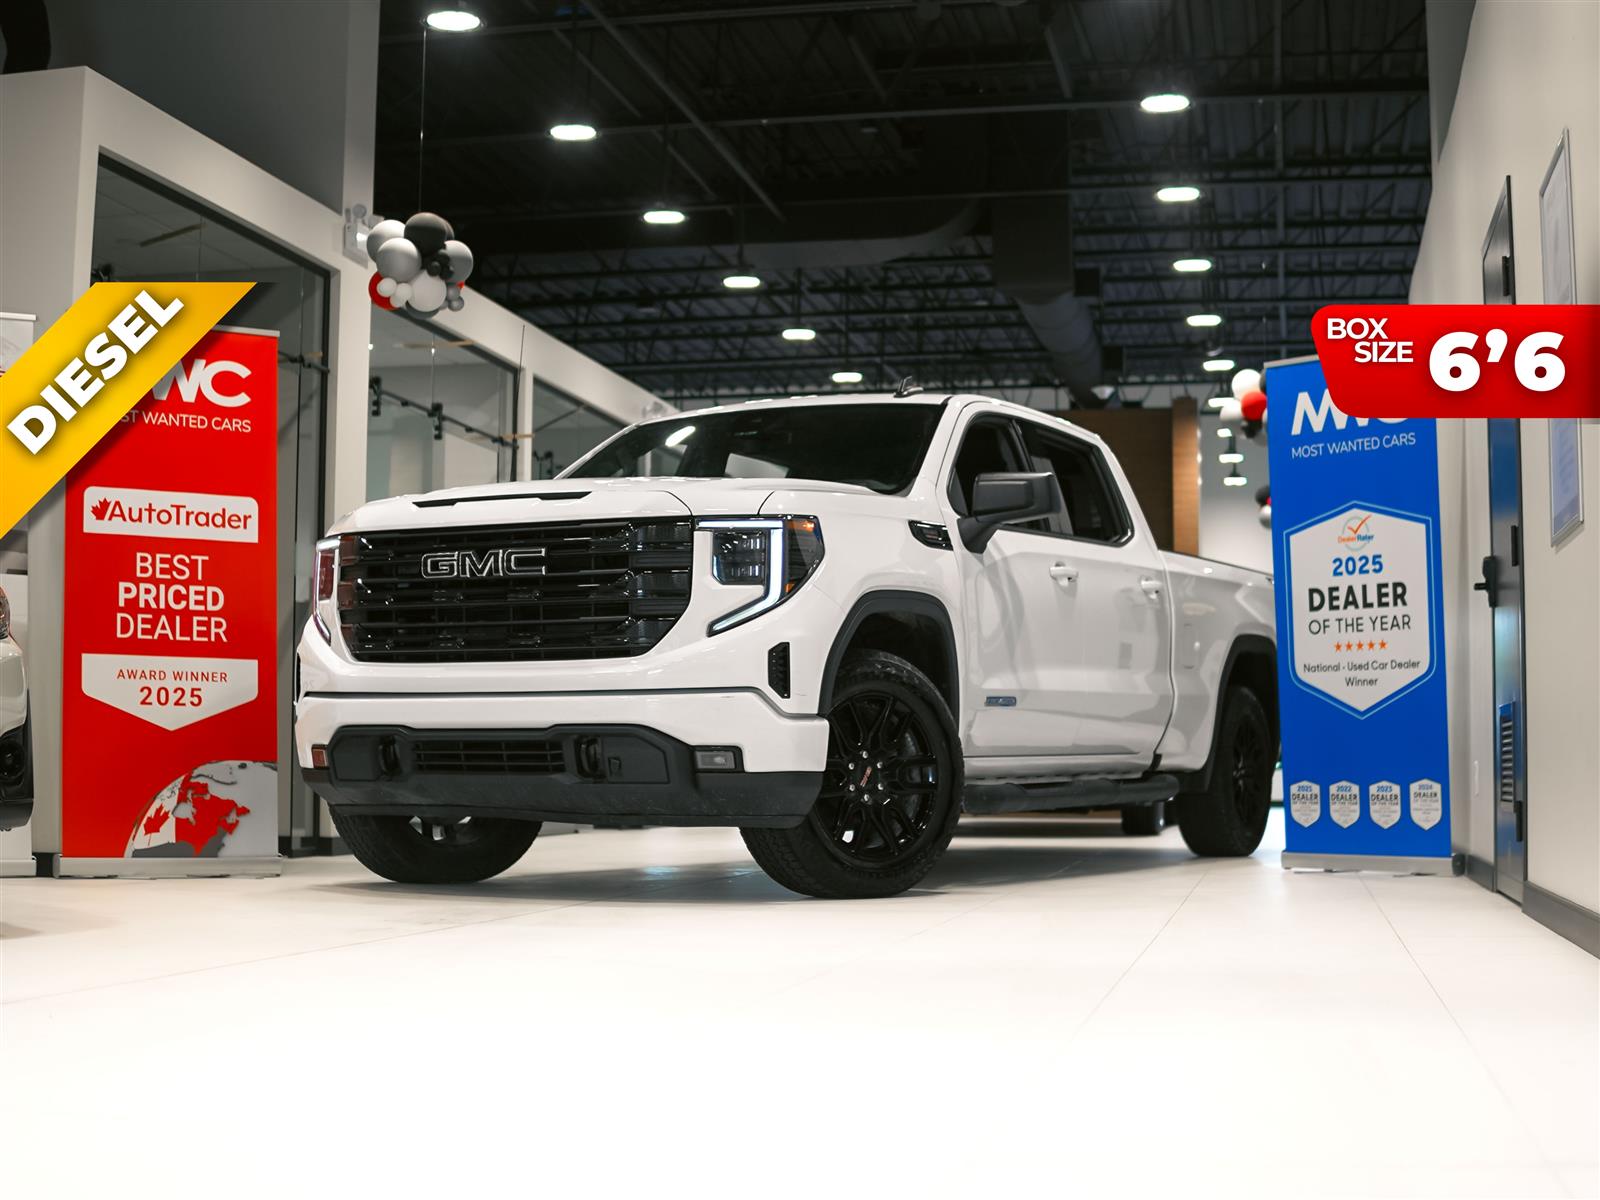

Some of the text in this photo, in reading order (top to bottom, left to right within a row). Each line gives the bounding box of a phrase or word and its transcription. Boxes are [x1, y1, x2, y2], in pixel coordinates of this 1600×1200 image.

[152, 358, 252, 408] WC
[142, 410, 208, 430] WANTED
[211, 416, 252, 434] CARS
[1291, 432, 1416, 459] MOST WANTED CARS
[108, 500, 252, 530] AutoTrader
[136, 552, 209, 581] BEST
[421, 547, 546, 579] GMC
[1332, 554, 1384, 577] 2025
[118, 581, 225, 612] PRICED
[1308, 582, 1408, 612] DEALER
[116, 612, 228, 643] DEALER
[1308, 614, 1411, 635] OF THE YEAR
[117, 669, 228, 683] AWARD WINNER
[1303, 661, 1340, 674] National
[1347, 660, 1369, 671] Used
[1371, 659, 1389, 671] Car
[1390, 659, 1420, 670] Dealer
[1345, 676, 1378, 687] Winner
[139, 686, 203, 707] 2025
[1292, 793, 1318, 801] DEALER
[1331, 793, 1357, 801] DEALER
[1371, 793, 1398, 801] DEALER
[1413, 791, 1438, 799] DEALER
